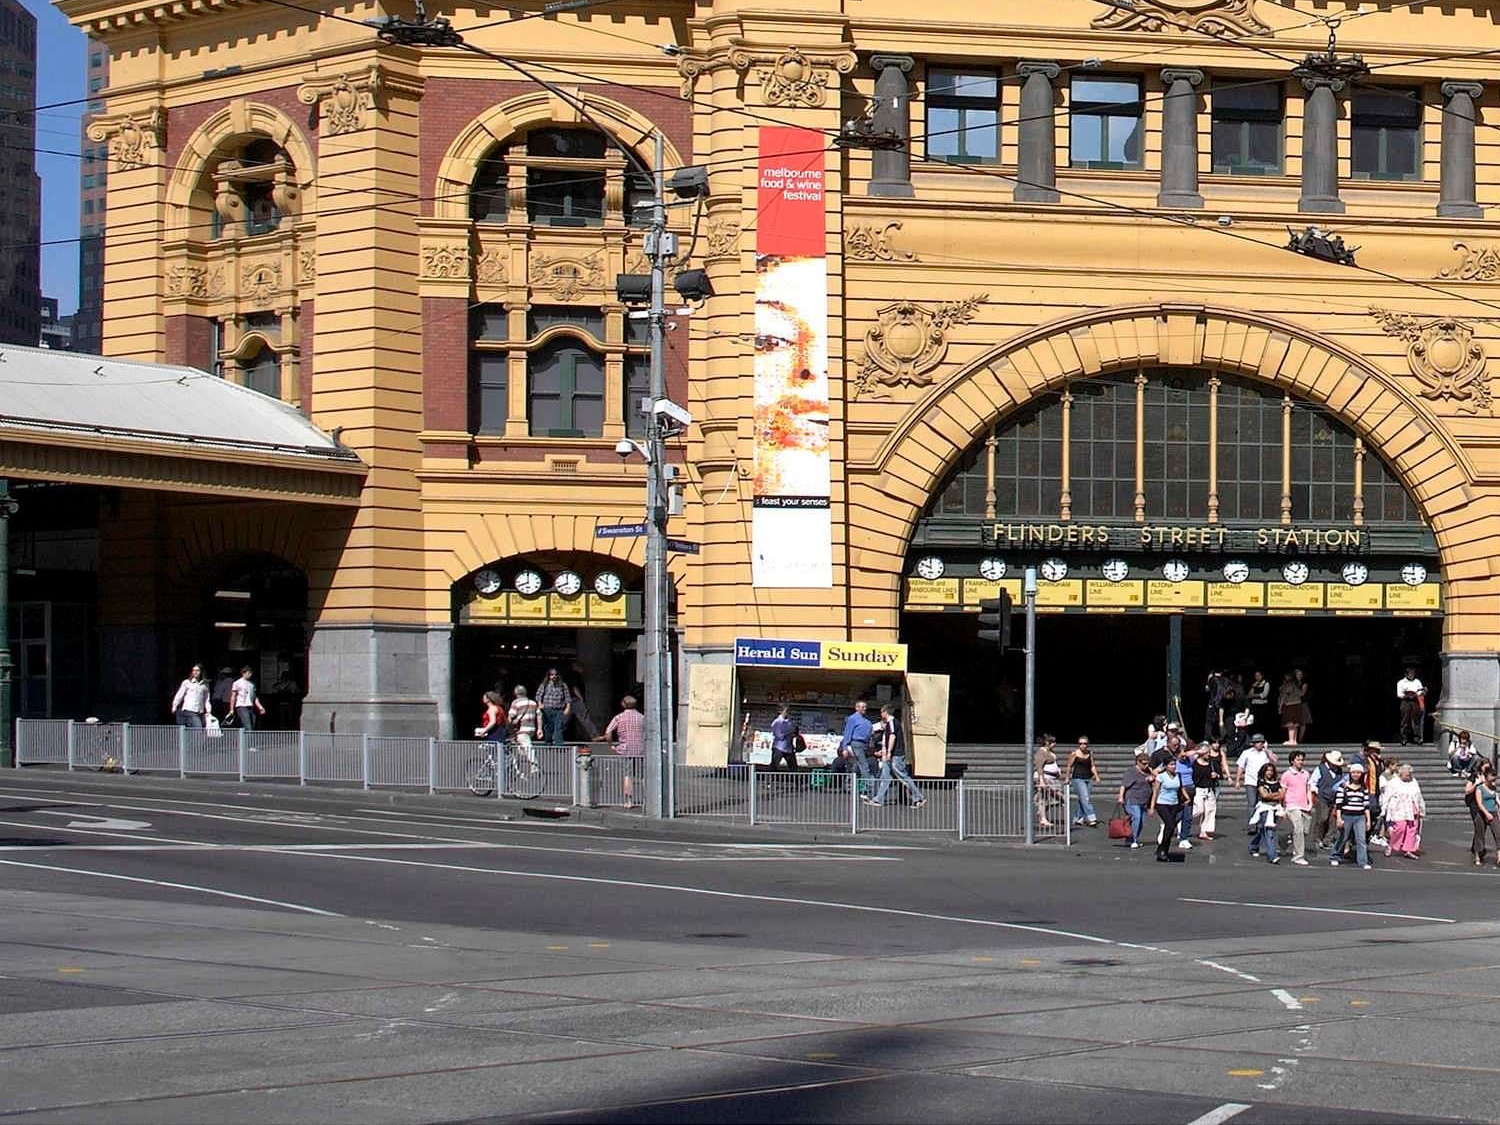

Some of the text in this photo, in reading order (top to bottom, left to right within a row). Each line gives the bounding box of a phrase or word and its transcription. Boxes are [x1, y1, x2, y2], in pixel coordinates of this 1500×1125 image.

[763, 167, 822, 179] melbourne
[760, 178, 822, 190] food & wine
[783, 190, 822, 201] festival
[761, 496, 780, 505] feast
[781, 498, 800, 507] your
[801, 498, 828, 506] senses
[602, 527, 634, 535] Swanston
[993, 523, 1361, 546] FLINDERS STREET STATION
[737, 646, 819, 660] Herald Sun
[828, 647, 899, 666] Sunday
